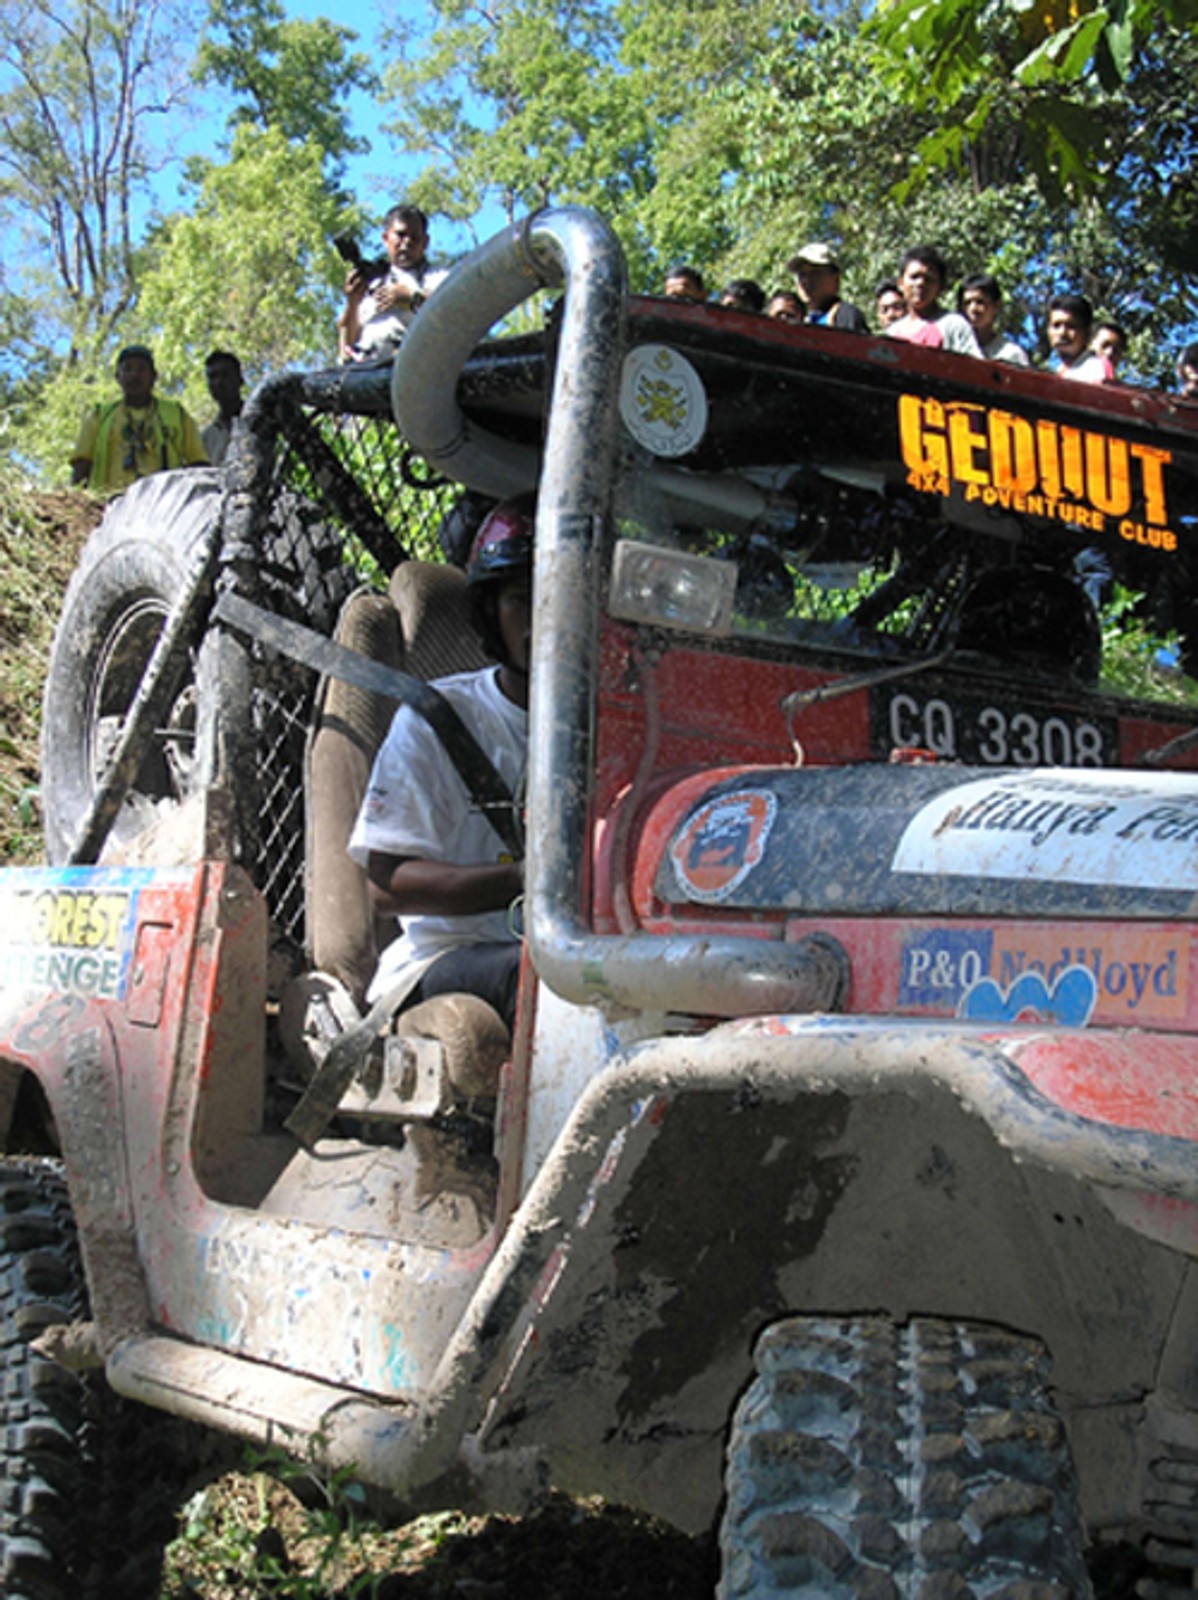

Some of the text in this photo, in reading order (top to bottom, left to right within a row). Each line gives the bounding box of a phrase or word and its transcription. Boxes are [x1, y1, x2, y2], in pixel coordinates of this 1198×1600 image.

[965, 484, 1106, 533] ADVENTURE
[1118, 519, 1179, 552] CLUB
[889, 693, 1103, 767] CQ 3308
[907, 949, 982, 990] P&O
